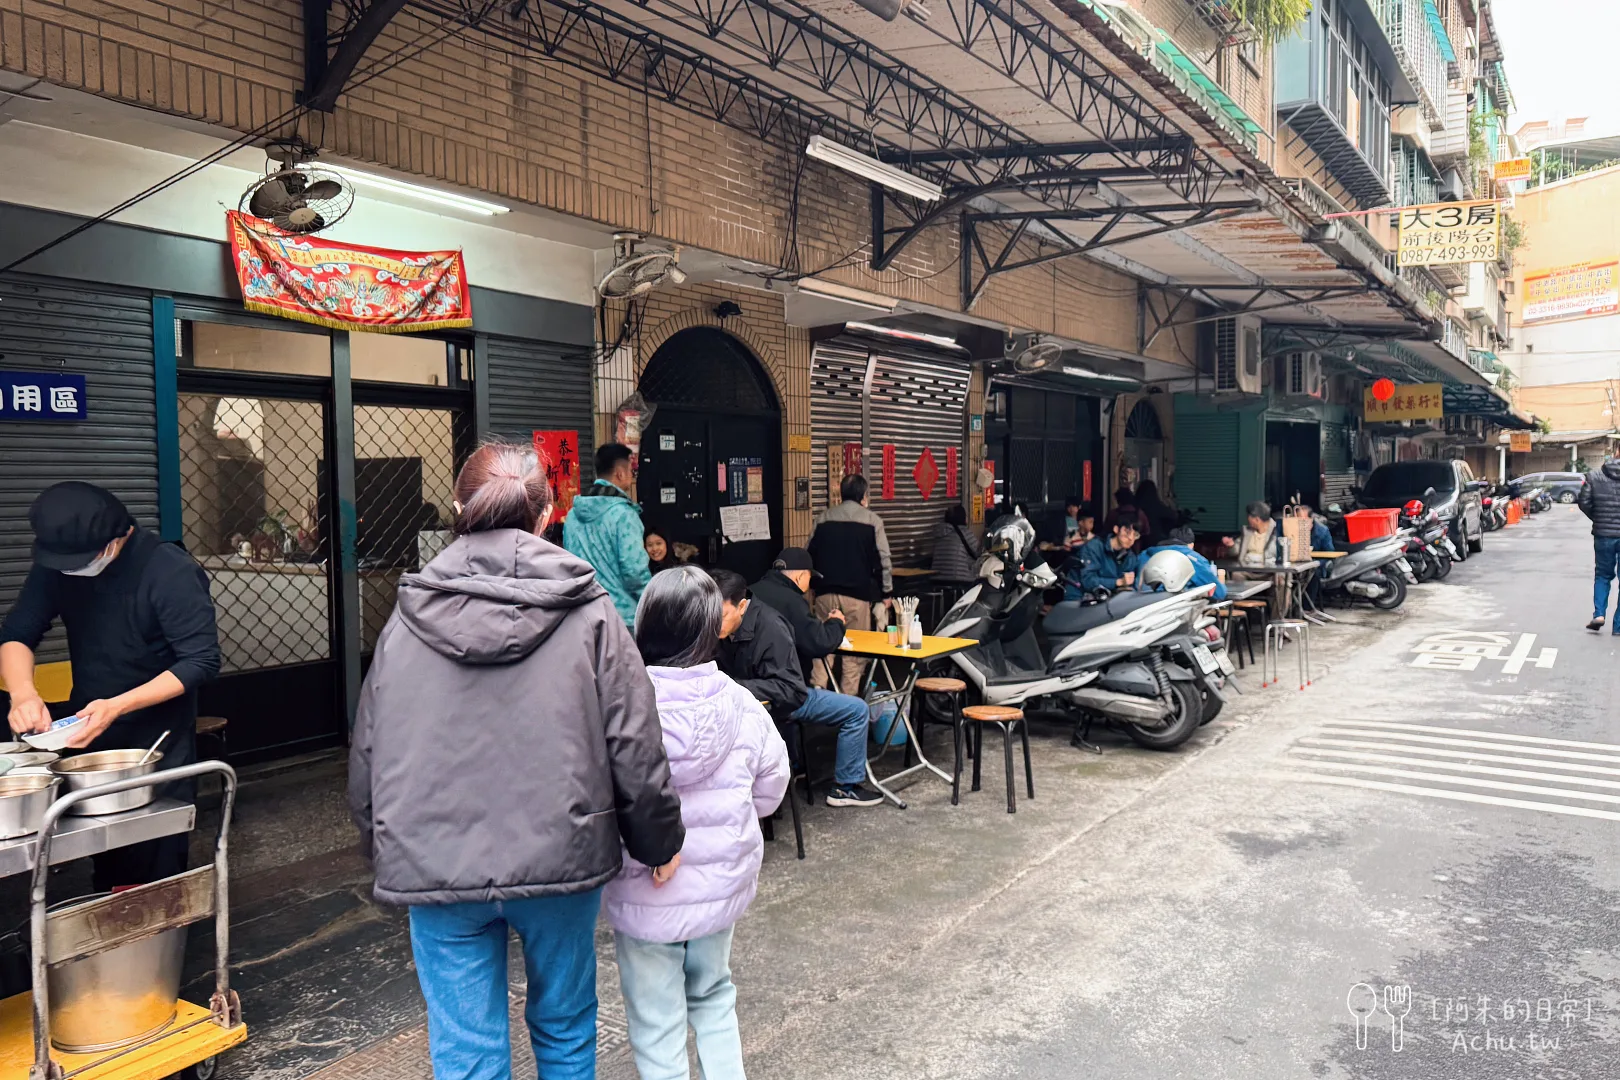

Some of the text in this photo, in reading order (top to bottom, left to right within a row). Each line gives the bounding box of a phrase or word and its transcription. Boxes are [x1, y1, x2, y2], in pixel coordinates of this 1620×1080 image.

[1403, 203, 1497, 230] 大3房
[1403, 228, 1495, 247] 前後陽台
[1401, 244, 1496, 263] 0987-493-993
[0, 384, 78, 413] 用區
[558, 438, 573, 477] 恭賀
[1409, 628, 1558, 675] 慢
